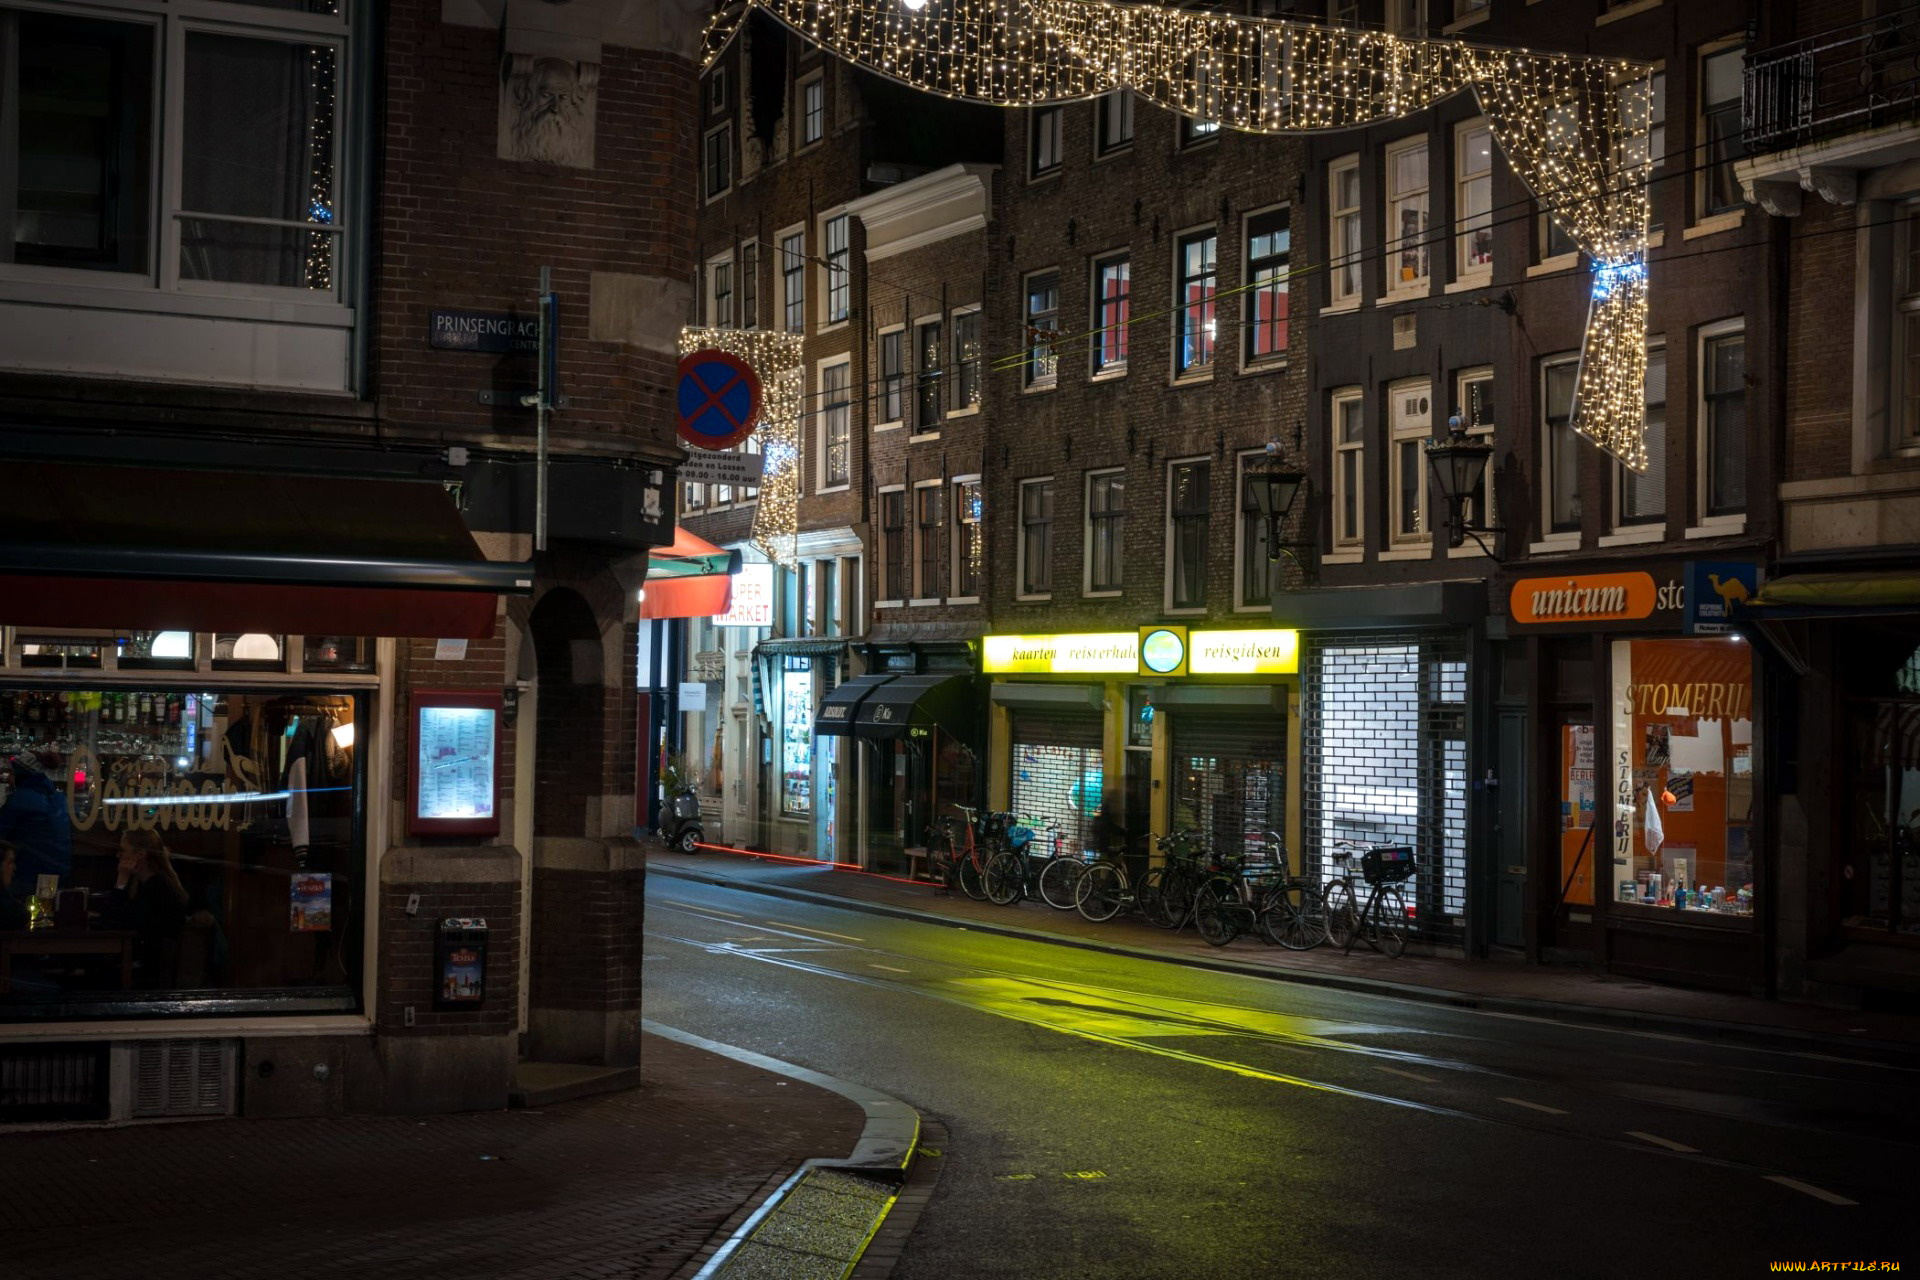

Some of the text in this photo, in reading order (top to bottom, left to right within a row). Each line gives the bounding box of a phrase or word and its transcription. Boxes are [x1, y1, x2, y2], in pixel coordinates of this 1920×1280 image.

[689, 452, 741, 462] itgezonderd
[717, 463, 746, 472] Lossen
[1531, 580, 1626, 616] unicum
[1012, 646, 1057, 661] kaarten
[1204, 643, 1281, 662] reisgidsen
[1623, 682, 1745, 723] STOMERIJ
